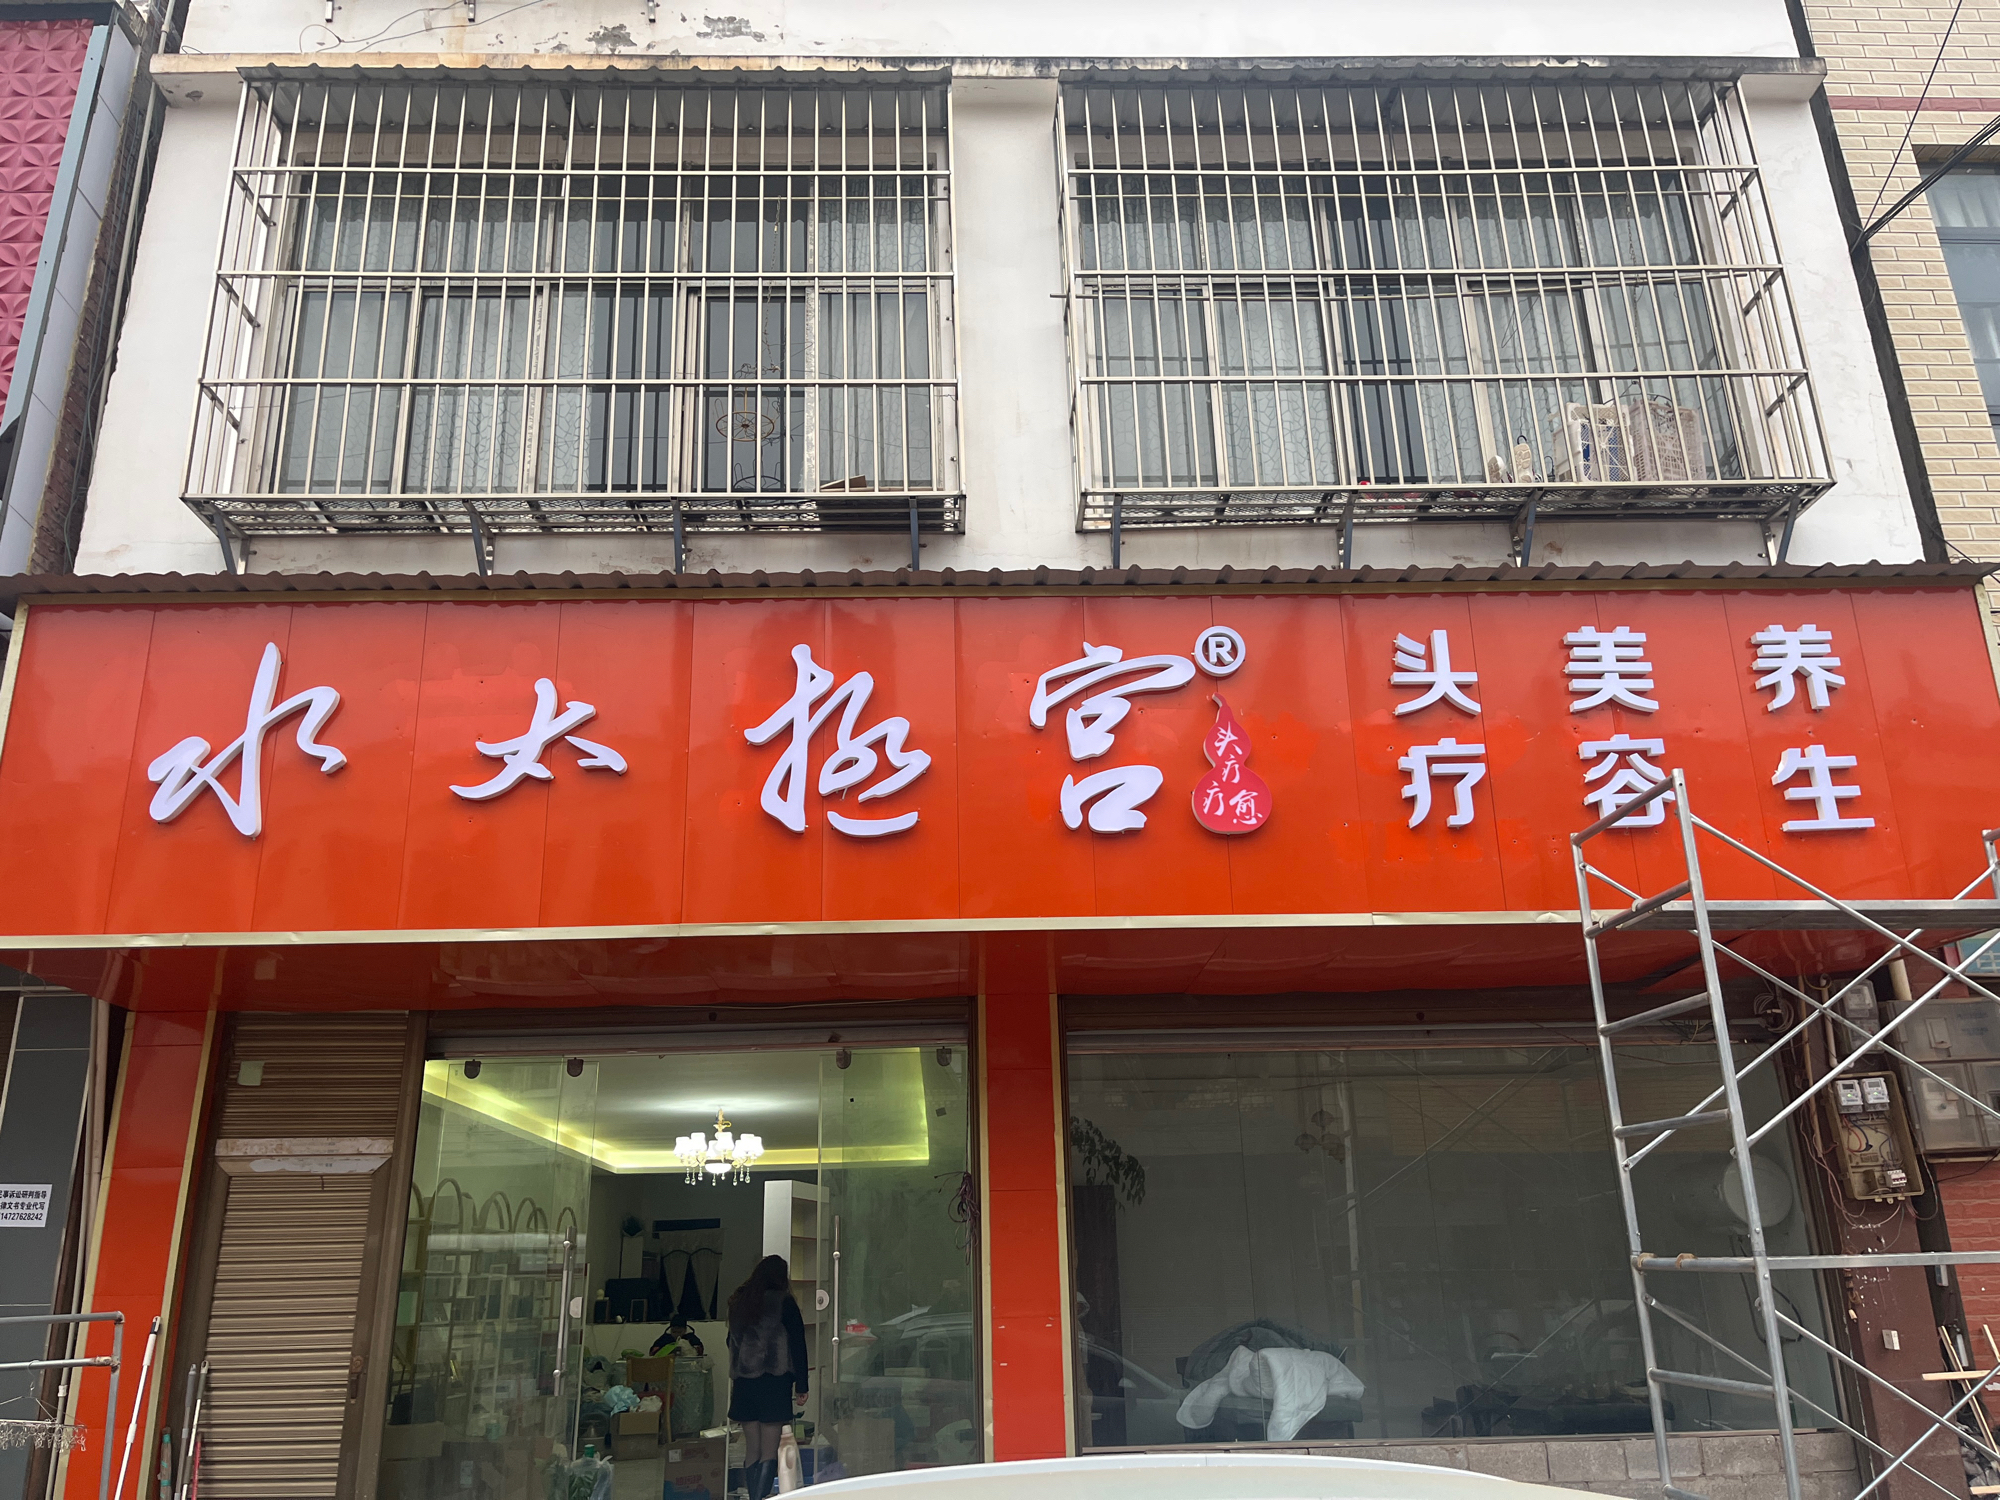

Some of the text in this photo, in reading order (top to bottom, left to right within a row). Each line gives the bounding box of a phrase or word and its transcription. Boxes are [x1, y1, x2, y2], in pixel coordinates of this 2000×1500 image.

[0, 1202, 45, 1210] 律文书专业代写
[1, 1213, 43, 1221] 14727628242
